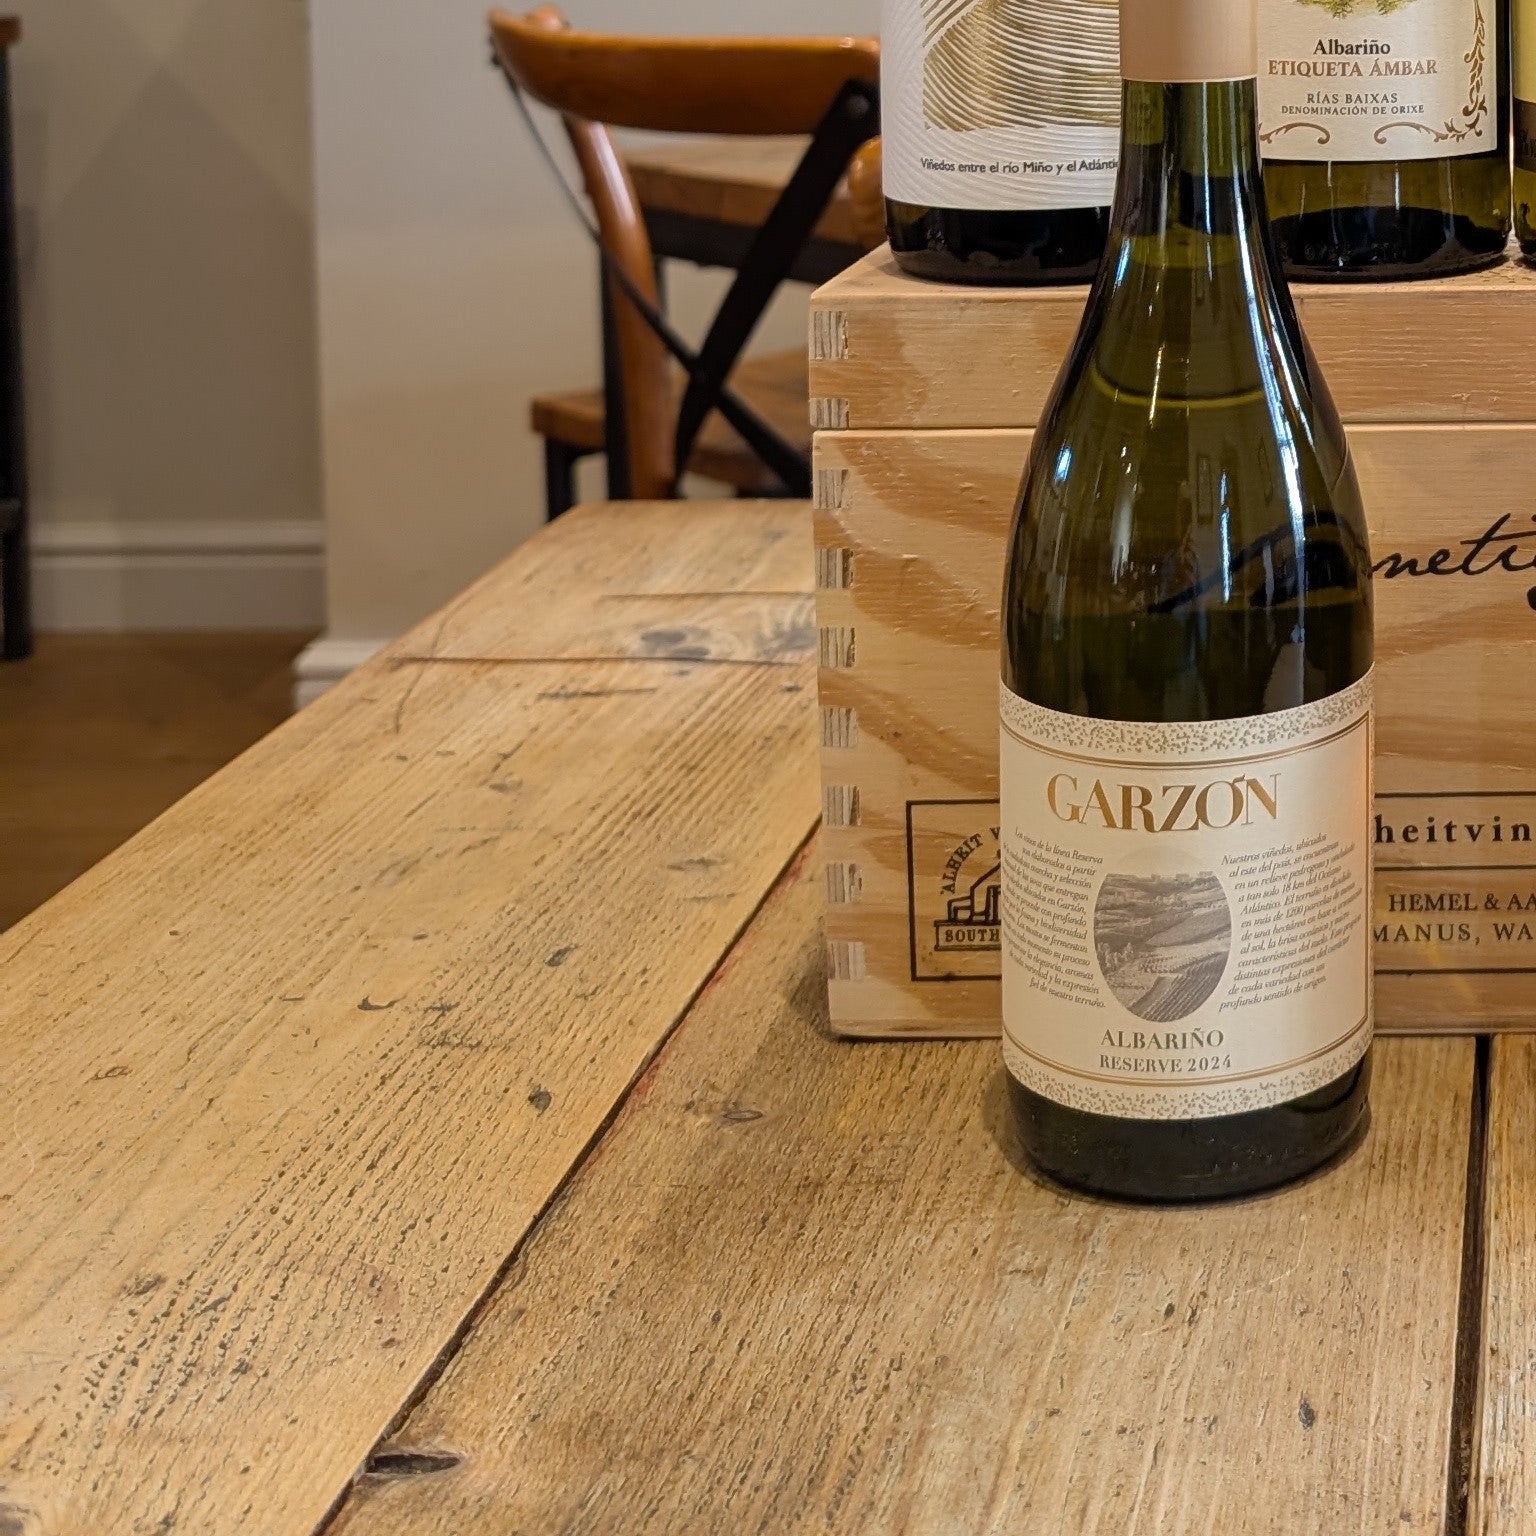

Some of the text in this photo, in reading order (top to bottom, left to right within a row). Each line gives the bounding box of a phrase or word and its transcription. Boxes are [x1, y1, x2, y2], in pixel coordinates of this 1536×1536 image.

[1313, 39, 1391, 55] Albariño
[1268, 58, 1438, 78] ETIQUETA ÁMBAR
[1307, 91, 1398, 104] RÍAS BAIXAS
[1281, 105, 1425, 115] DENOMINACIÓN DE ORIXE
[920, 157, 1119, 175] Viñedos entre el río Miño y el Atlántic
[1047, 772, 1281, 833] GARZÓN
[1072, 850, 1104, 864] Reserva
[1221, 853, 1260, 865] Nuestros
[1241, 866, 1258, 876] este
[1258, 860, 1273, 873] del
[1389, 893, 1479, 912] HEMEL
[1484, 894, 1500, 910] &
[945, 928, 1000, 943] SOUTH
[1374, 923, 1481, 945] MANUS,
[1100, 1027, 1224, 1050] ALBARIÑO
[1100, 1054, 1232, 1074] RESERVE 2024
